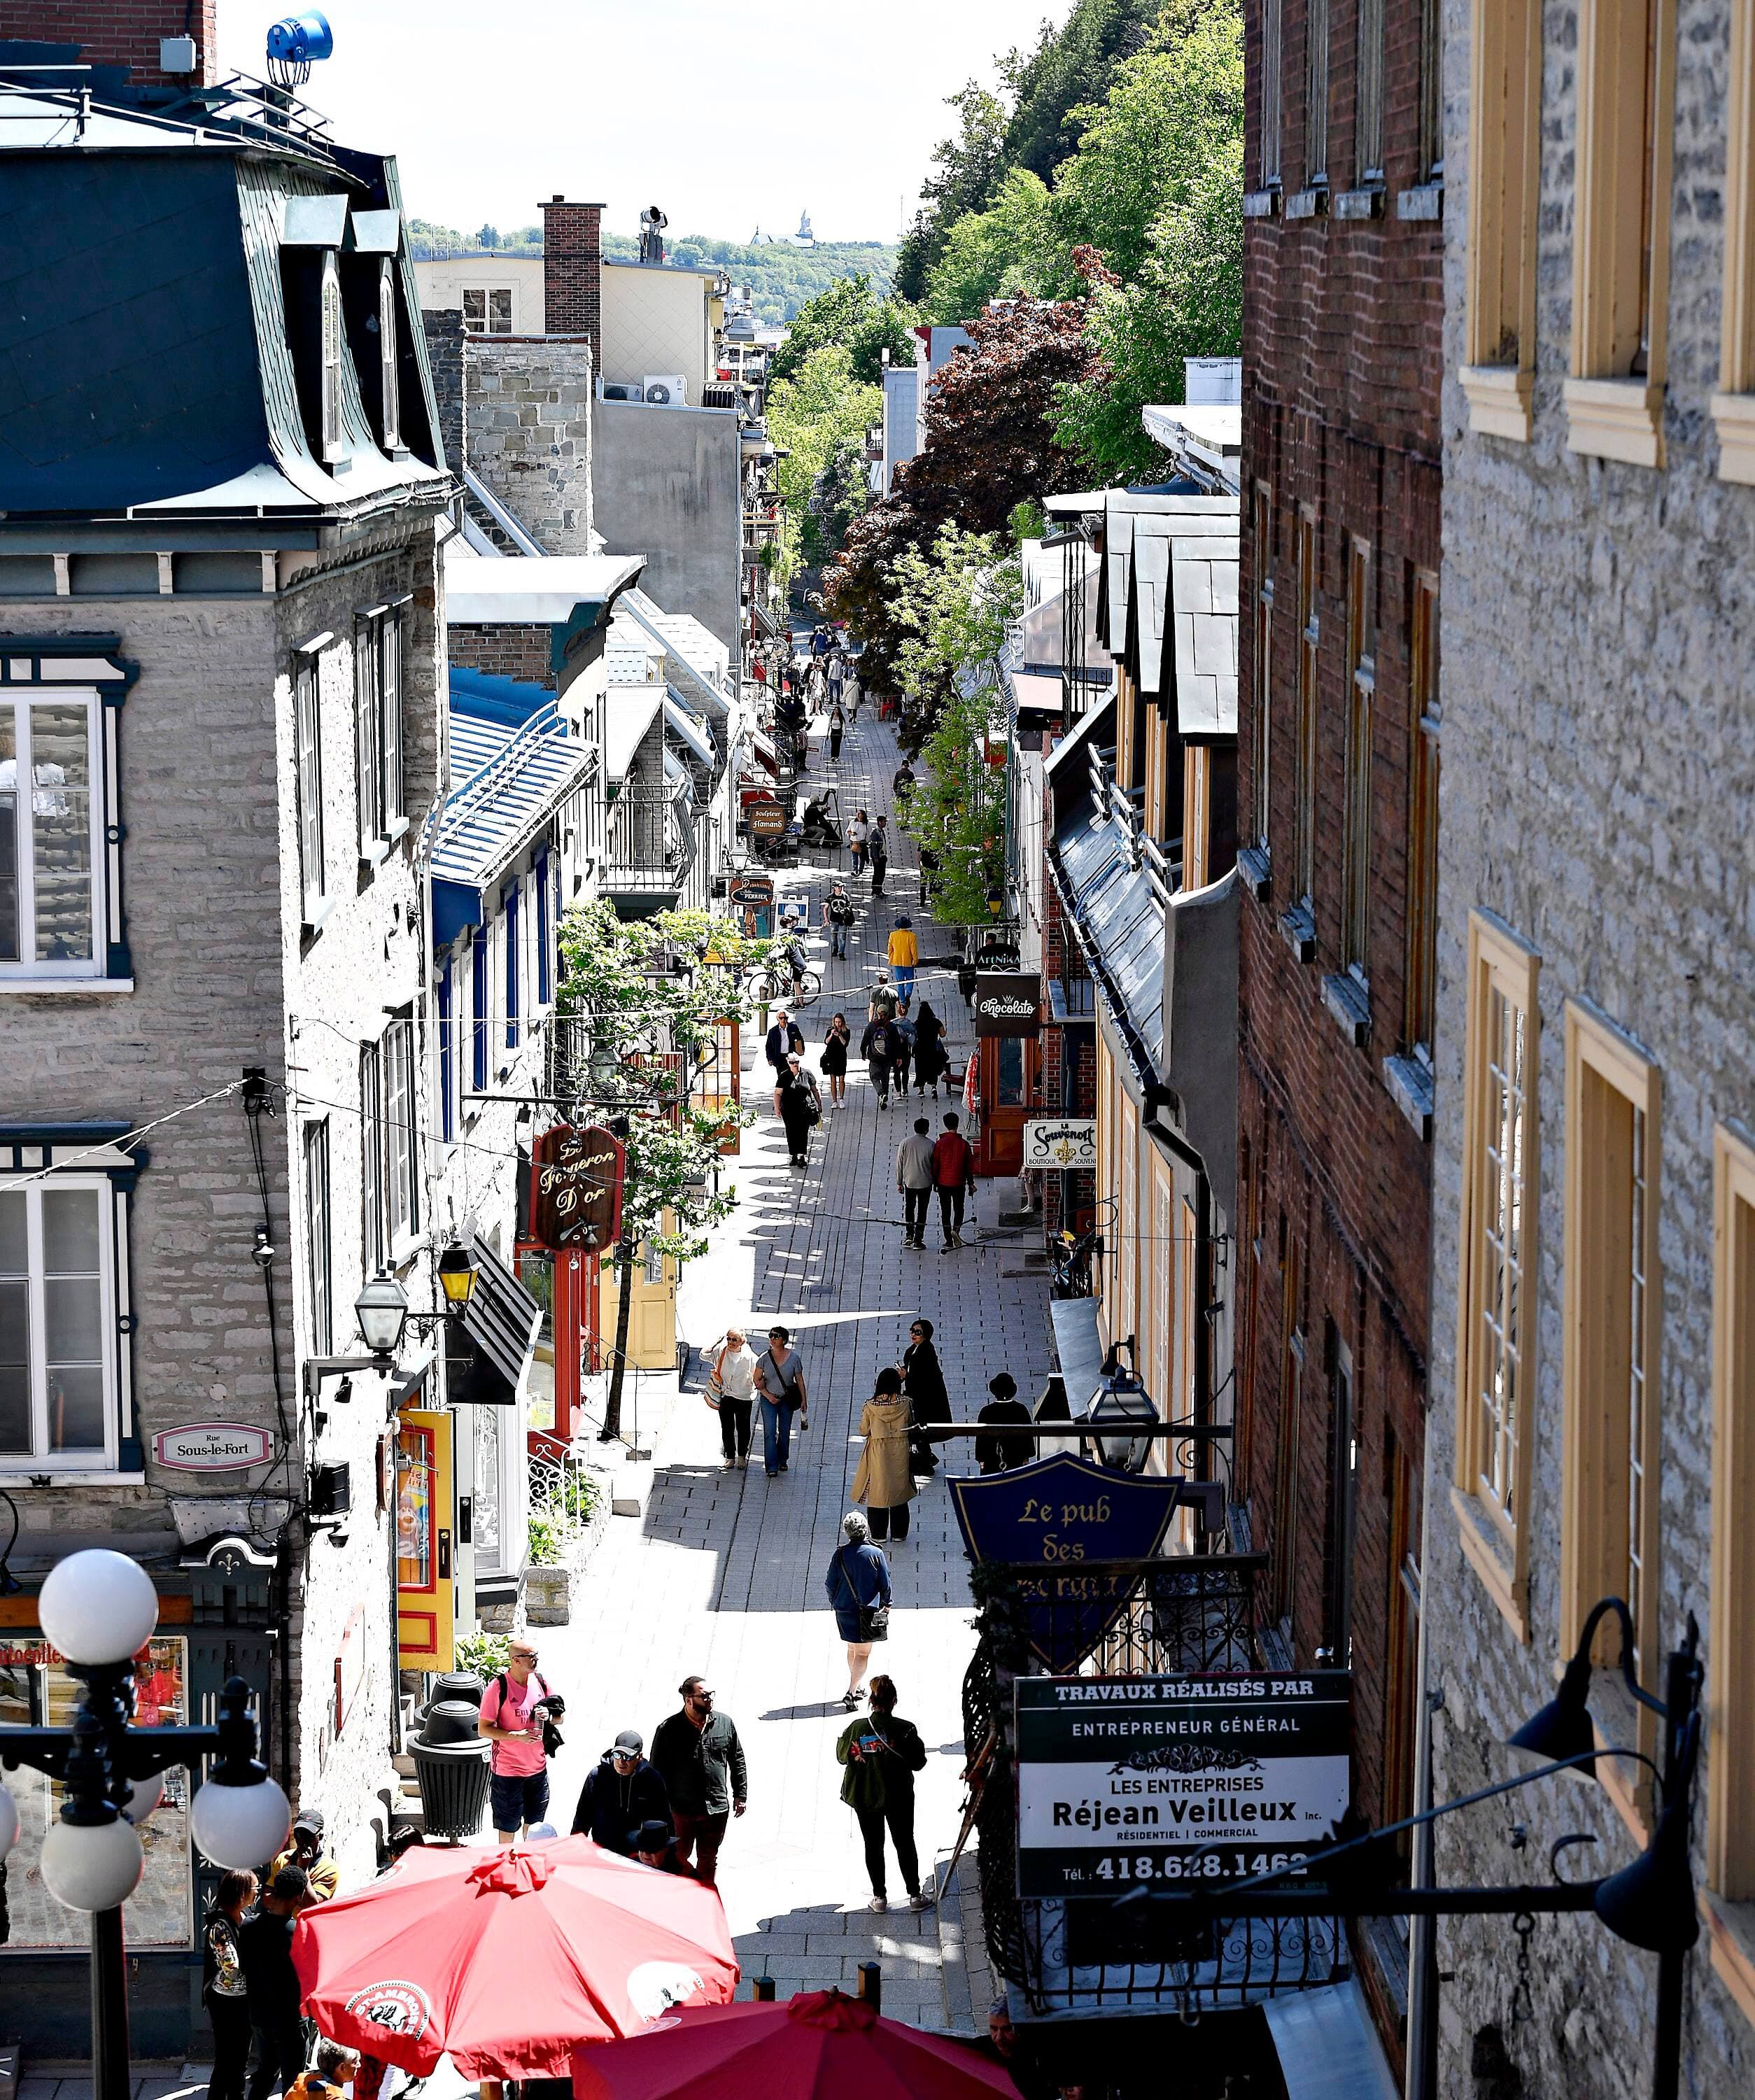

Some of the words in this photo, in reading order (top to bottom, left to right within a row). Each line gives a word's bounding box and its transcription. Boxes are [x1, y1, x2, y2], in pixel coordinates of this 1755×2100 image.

[752, 819, 782, 829] Flamand
[980, 998, 1036, 1018] Chocolato
[540, 1152, 616, 1195] Fogeron
[177, 1443, 249, 1456] Sous-le-Fort
[1017, 1498, 1052, 1523] Le
[1061, 1495, 1111, 1528] pub
[1043, 1533, 1085, 1561] des
[1055, 1684, 1157, 1701] TRAVAUX
[1162, 1679, 1266, 1698] RÉALISÉS
[1271, 1680, 1314, 1696] PAR
[1072, 1720, 1213, 1737] ENTREPRENEUR
[1220, 1716, 1301, 1733] GÉNÉRAL
[1111, 1780, 1143, 1795] LES
[1147, 1776, 1264, 1794] ENTREPRISES
[1052, 1799, 1160, 1831] Réjean
[1168, 1796, 1297, 1824] Veilleux
[1305, 1811, 1323, 1821] inc.
[1117, 1829, 1181, 1841] RÉSIDENTIEL
[1194, 1828, 1259, 1839] COMMERCIAL
[1095, 1852, 1309, 1880] 418.628.1462
